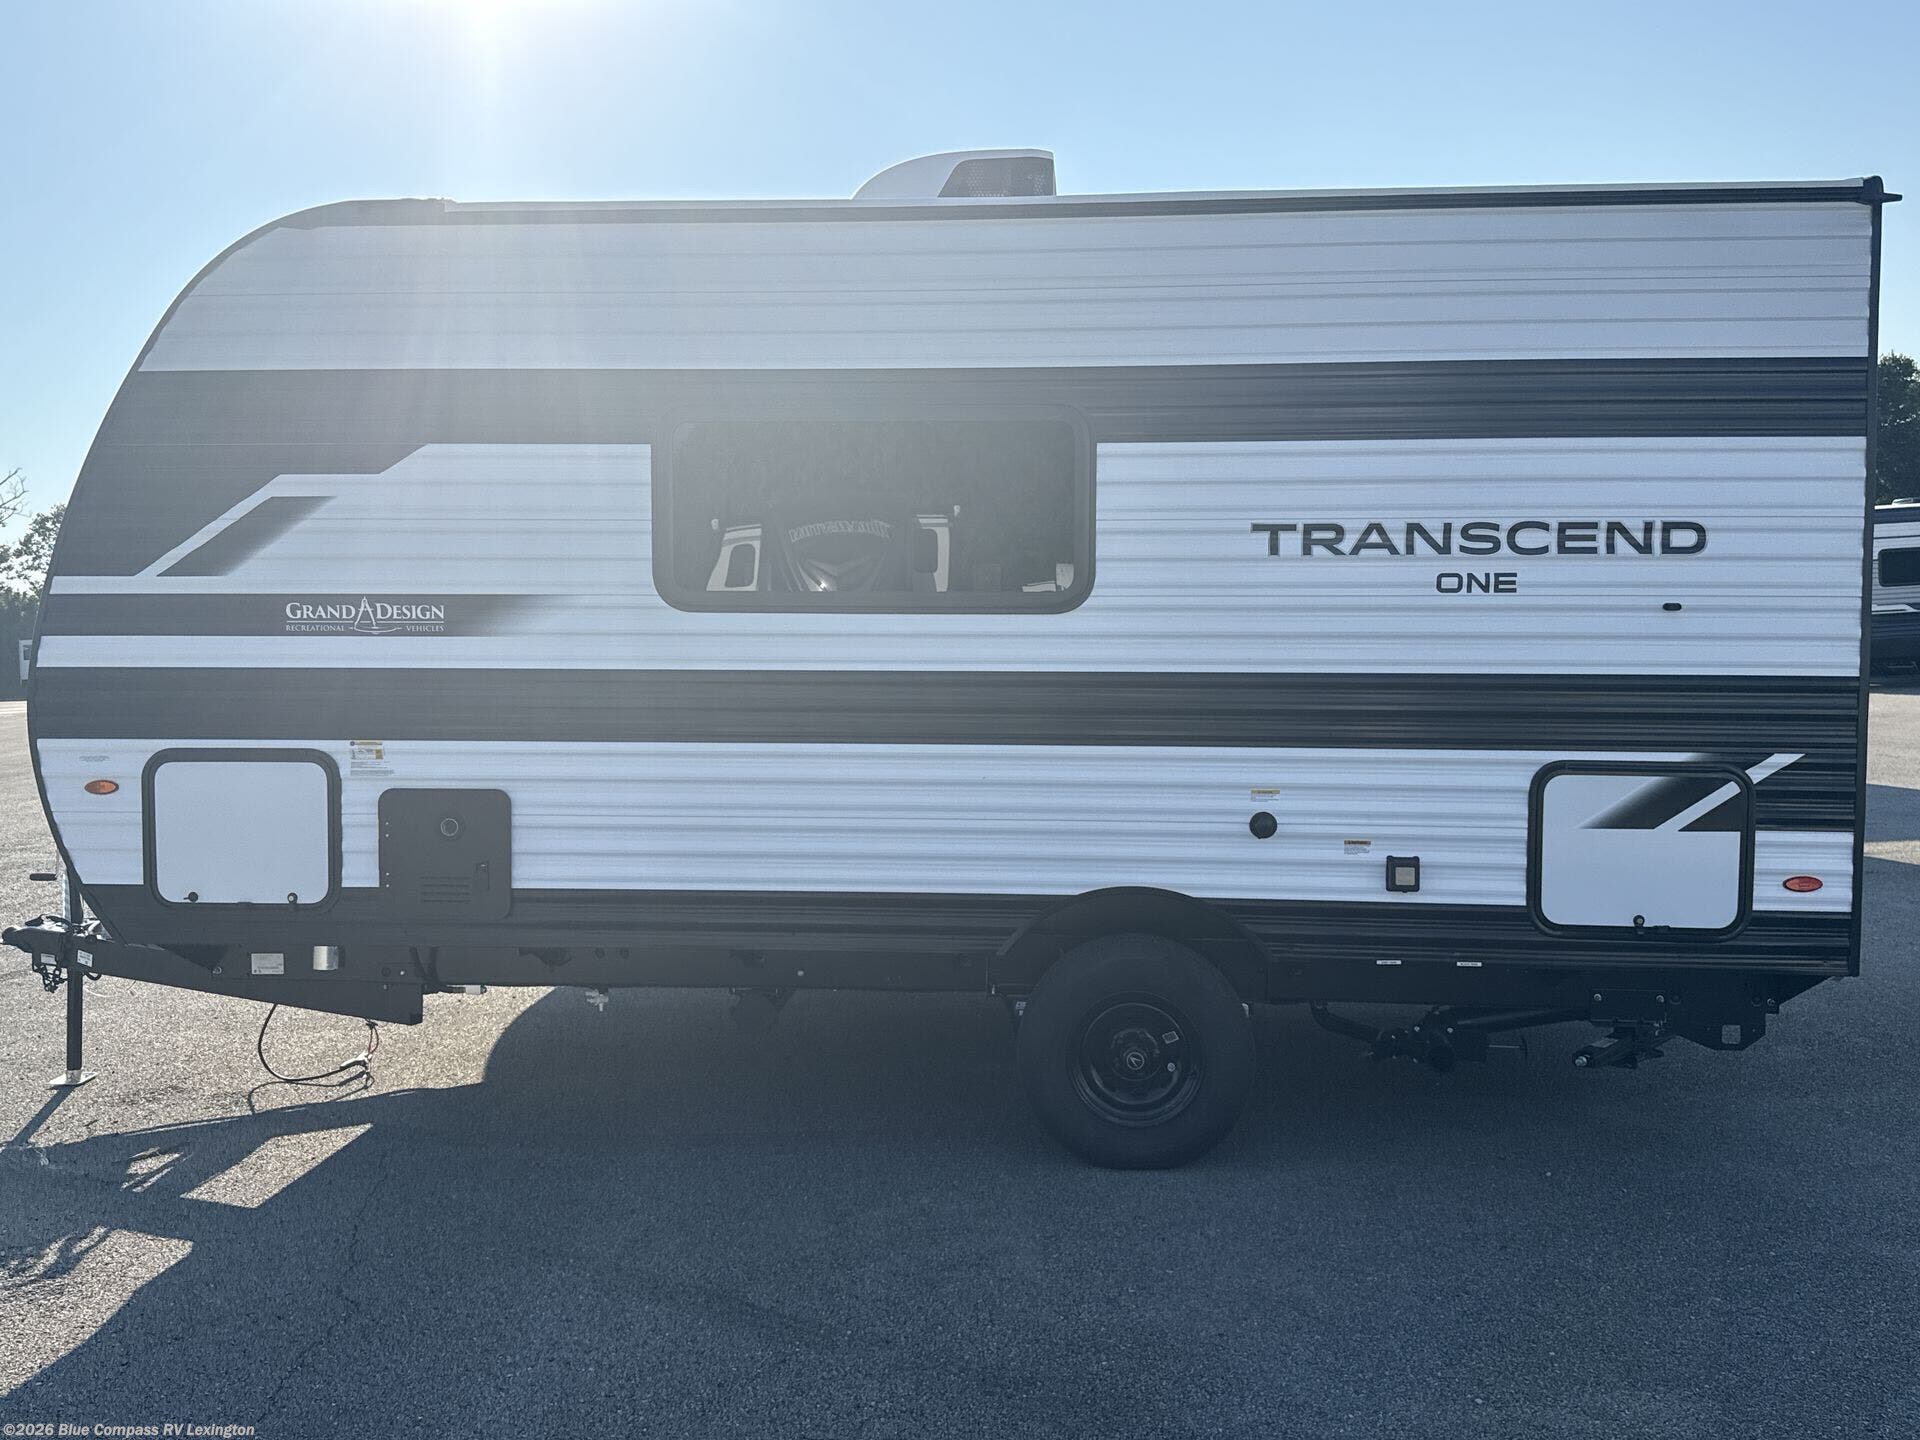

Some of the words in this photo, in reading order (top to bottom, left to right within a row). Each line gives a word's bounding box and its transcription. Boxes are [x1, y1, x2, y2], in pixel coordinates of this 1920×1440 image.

[1250, 520, 1708, 557] TRANSCEND
[1435, 572, 1518, 594] ONE
[285, 602, 356, 619] GRAND
[375, 602, 445, 619] DESIGN
[285, 624, 345, 632] RECREATIONAL
[406, 624, 444, 632] VEHICLES
